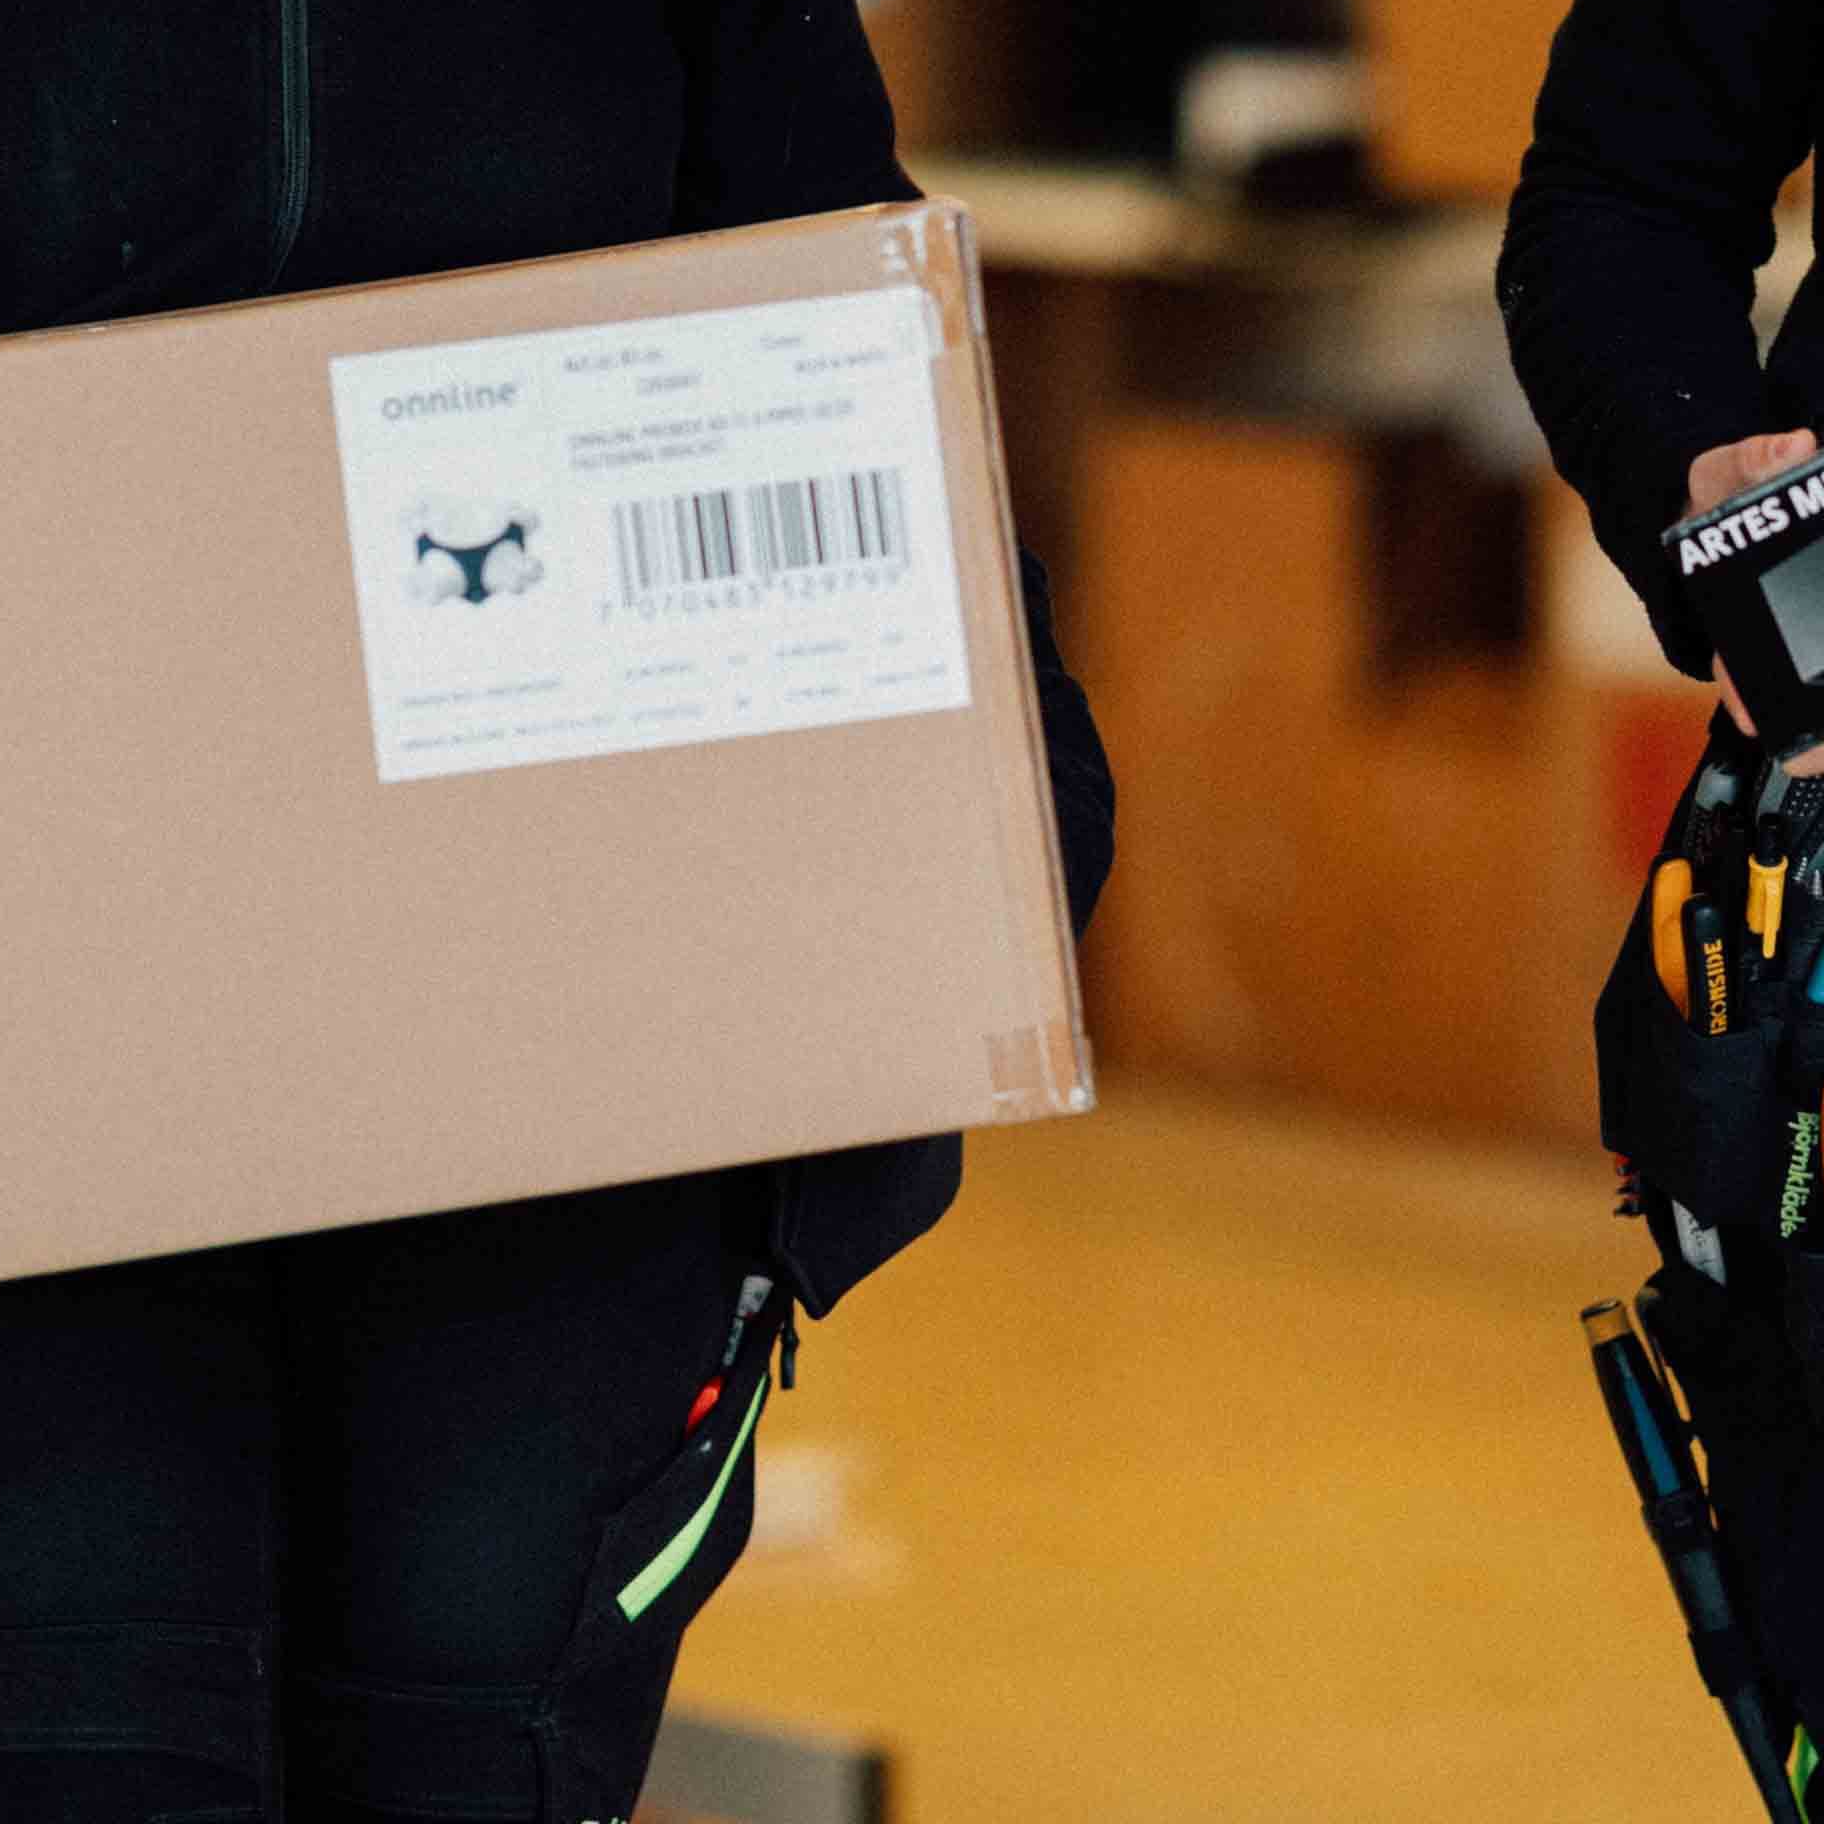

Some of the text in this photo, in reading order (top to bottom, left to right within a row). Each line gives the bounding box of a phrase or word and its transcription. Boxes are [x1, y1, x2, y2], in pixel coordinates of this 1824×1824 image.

[380, 382, 518, 422] onnline
[1679, 495, 1791, 576] ARTES
[1704, 938, 1728, 1035] IRONSIDE
